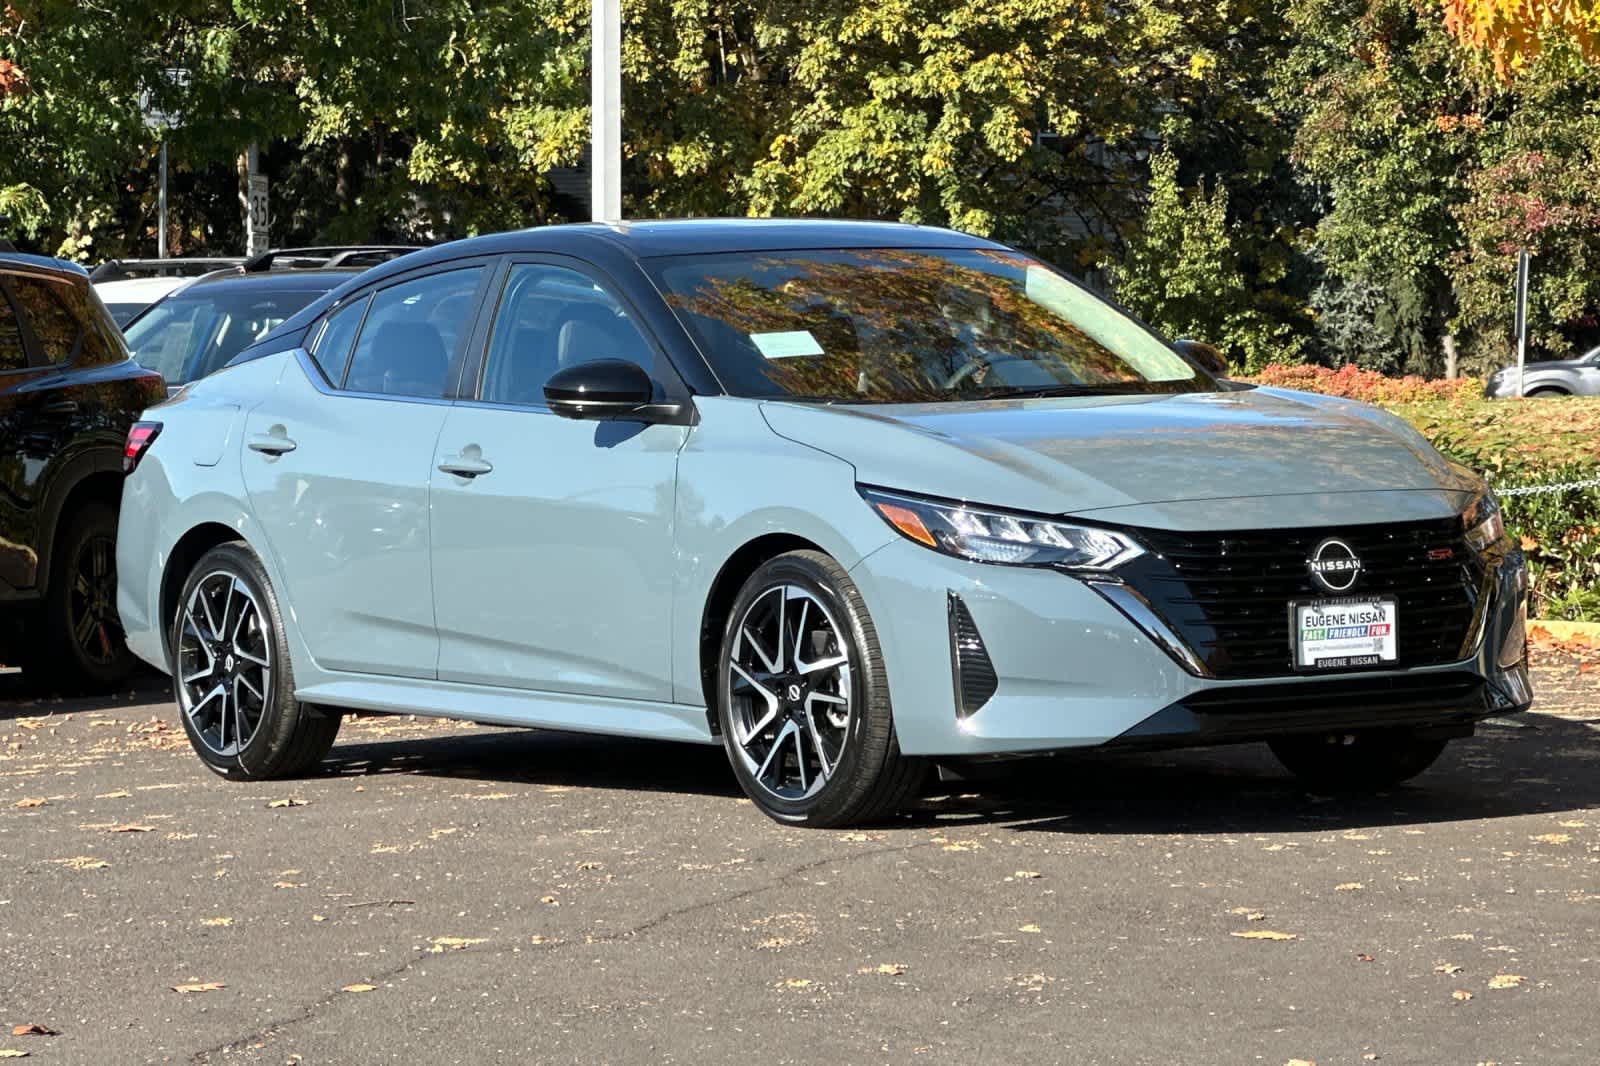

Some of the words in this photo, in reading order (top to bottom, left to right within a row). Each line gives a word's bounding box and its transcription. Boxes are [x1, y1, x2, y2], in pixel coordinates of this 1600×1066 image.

[252, 195, 267, 227] 35
[1311, 559, 1361, 572] NISSAN
[1305, 614, 1346, 627] EUGENE
[1349, 612, 1386, 624] NISSAN
[1317, 658, 1347, 668] EUGENE
[1350, 656, 1378, 666] NISSAN
